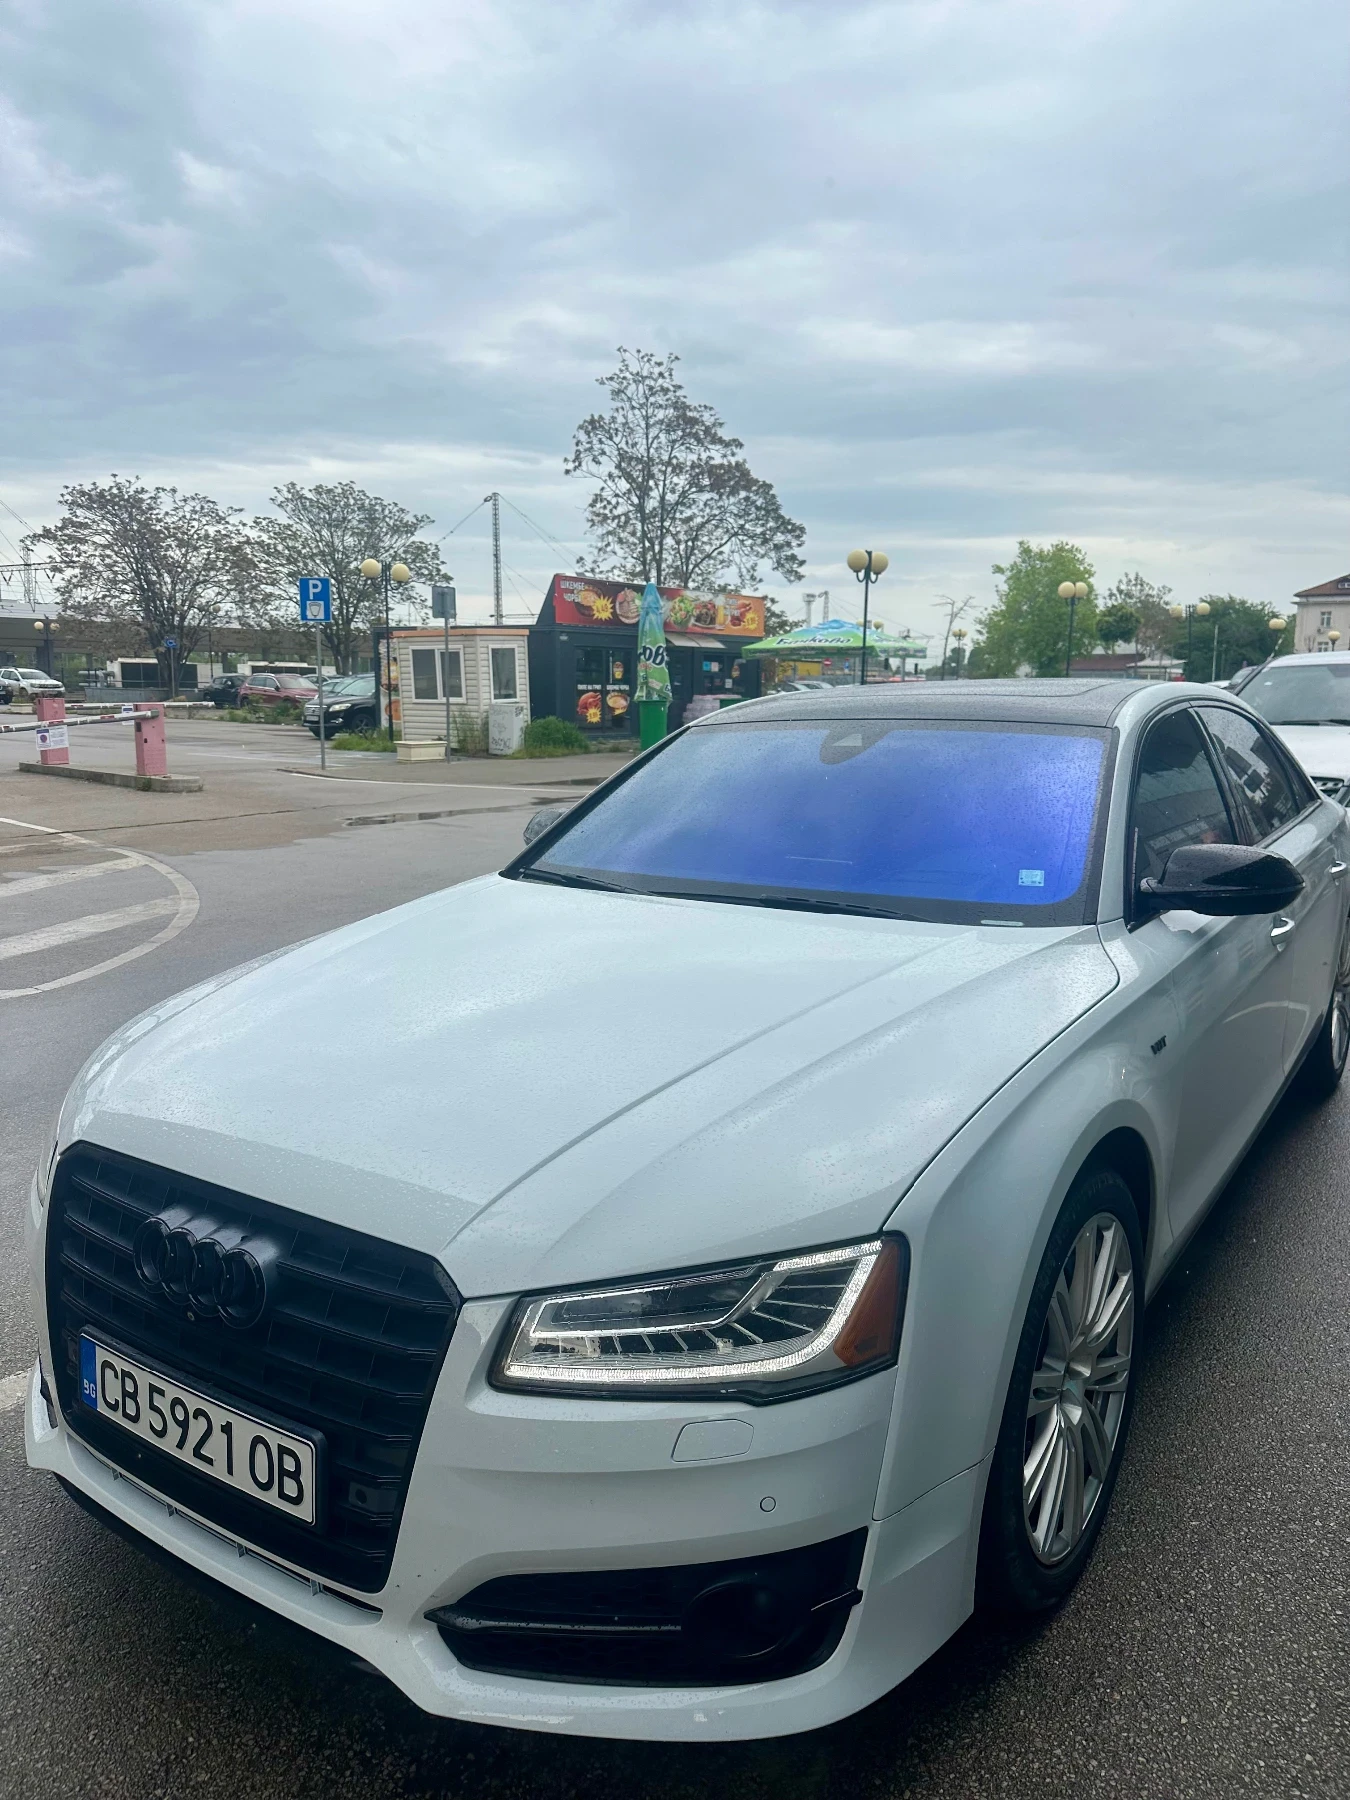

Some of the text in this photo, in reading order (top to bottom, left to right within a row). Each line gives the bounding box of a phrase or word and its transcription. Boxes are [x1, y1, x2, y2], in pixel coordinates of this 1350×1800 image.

[309, 579, 322, 600] P
[560, 580, 585, 590] ШКЕМБЕ
[83, 1379, 96, 1399] BG
